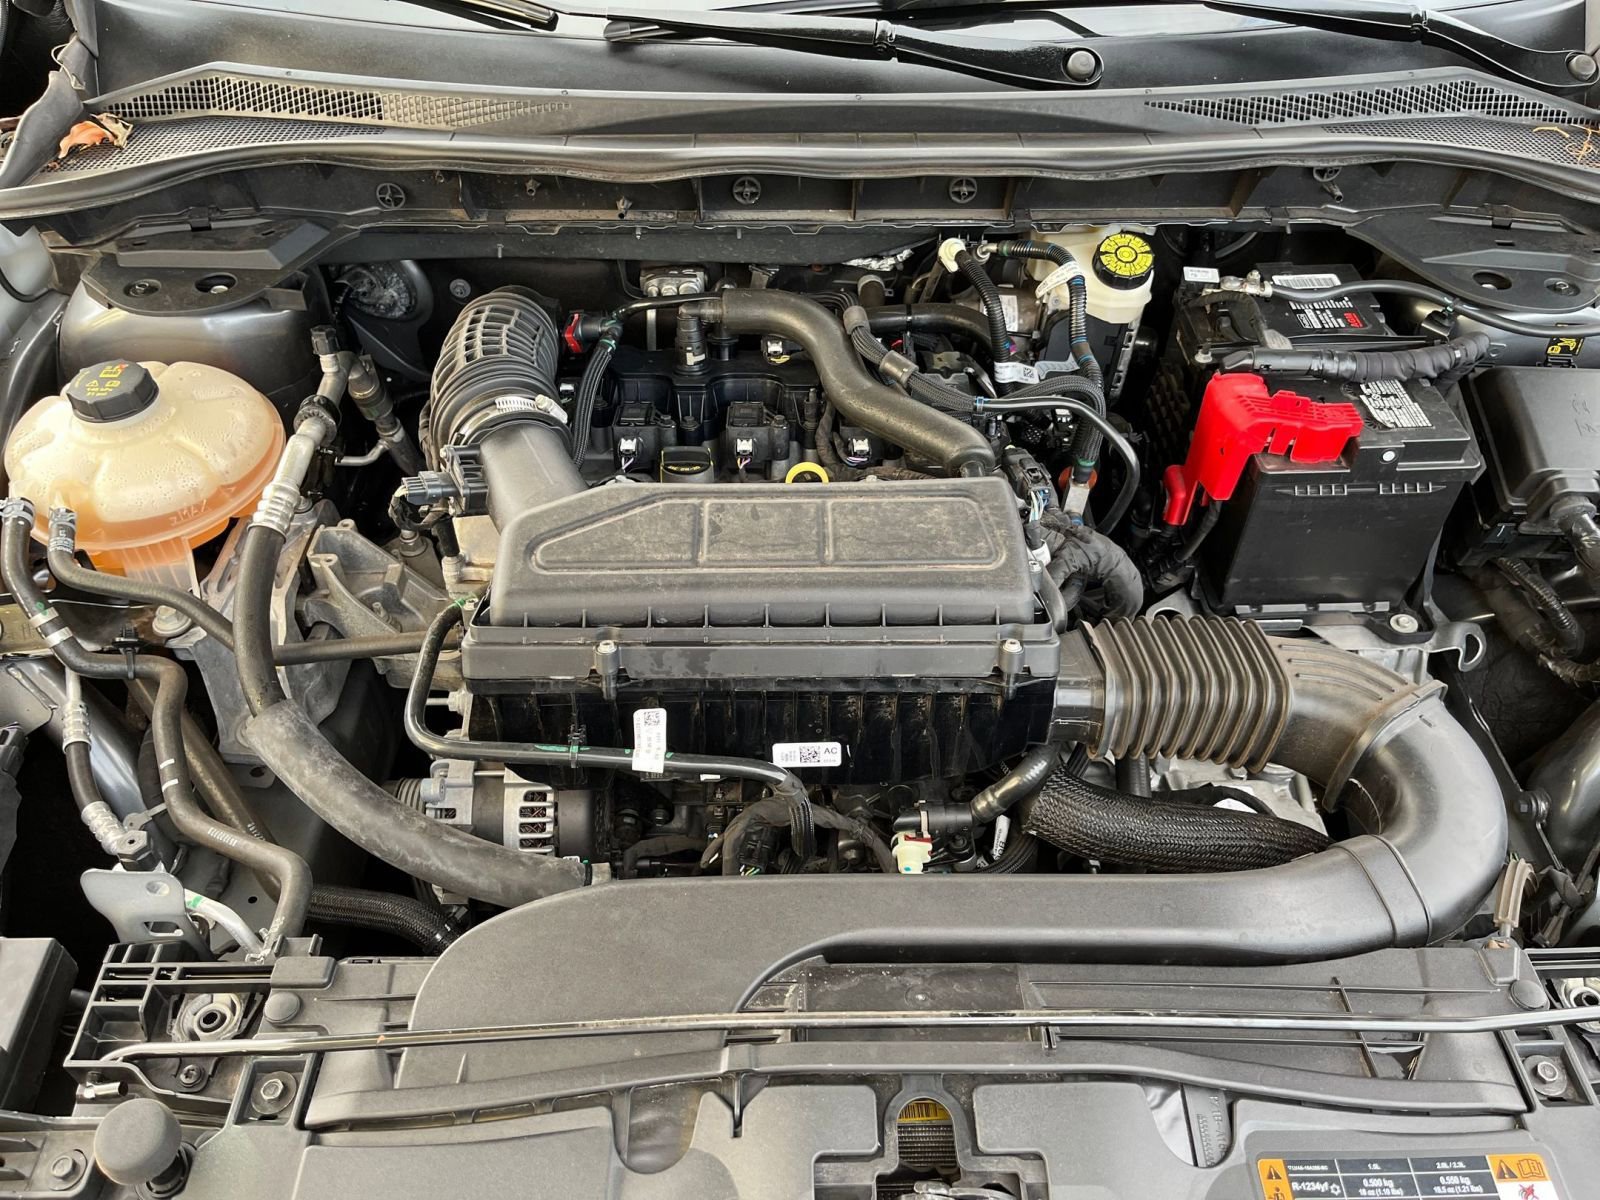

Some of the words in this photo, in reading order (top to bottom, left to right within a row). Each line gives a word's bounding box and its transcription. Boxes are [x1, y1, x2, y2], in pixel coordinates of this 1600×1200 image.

[824, 747, 838, 755] AC
[1383, 1178, 1394, 1188] kg
[1460, 1176, 1471, 1185] kg
[1291, 1181, 1329, 1193] R-1234yf
